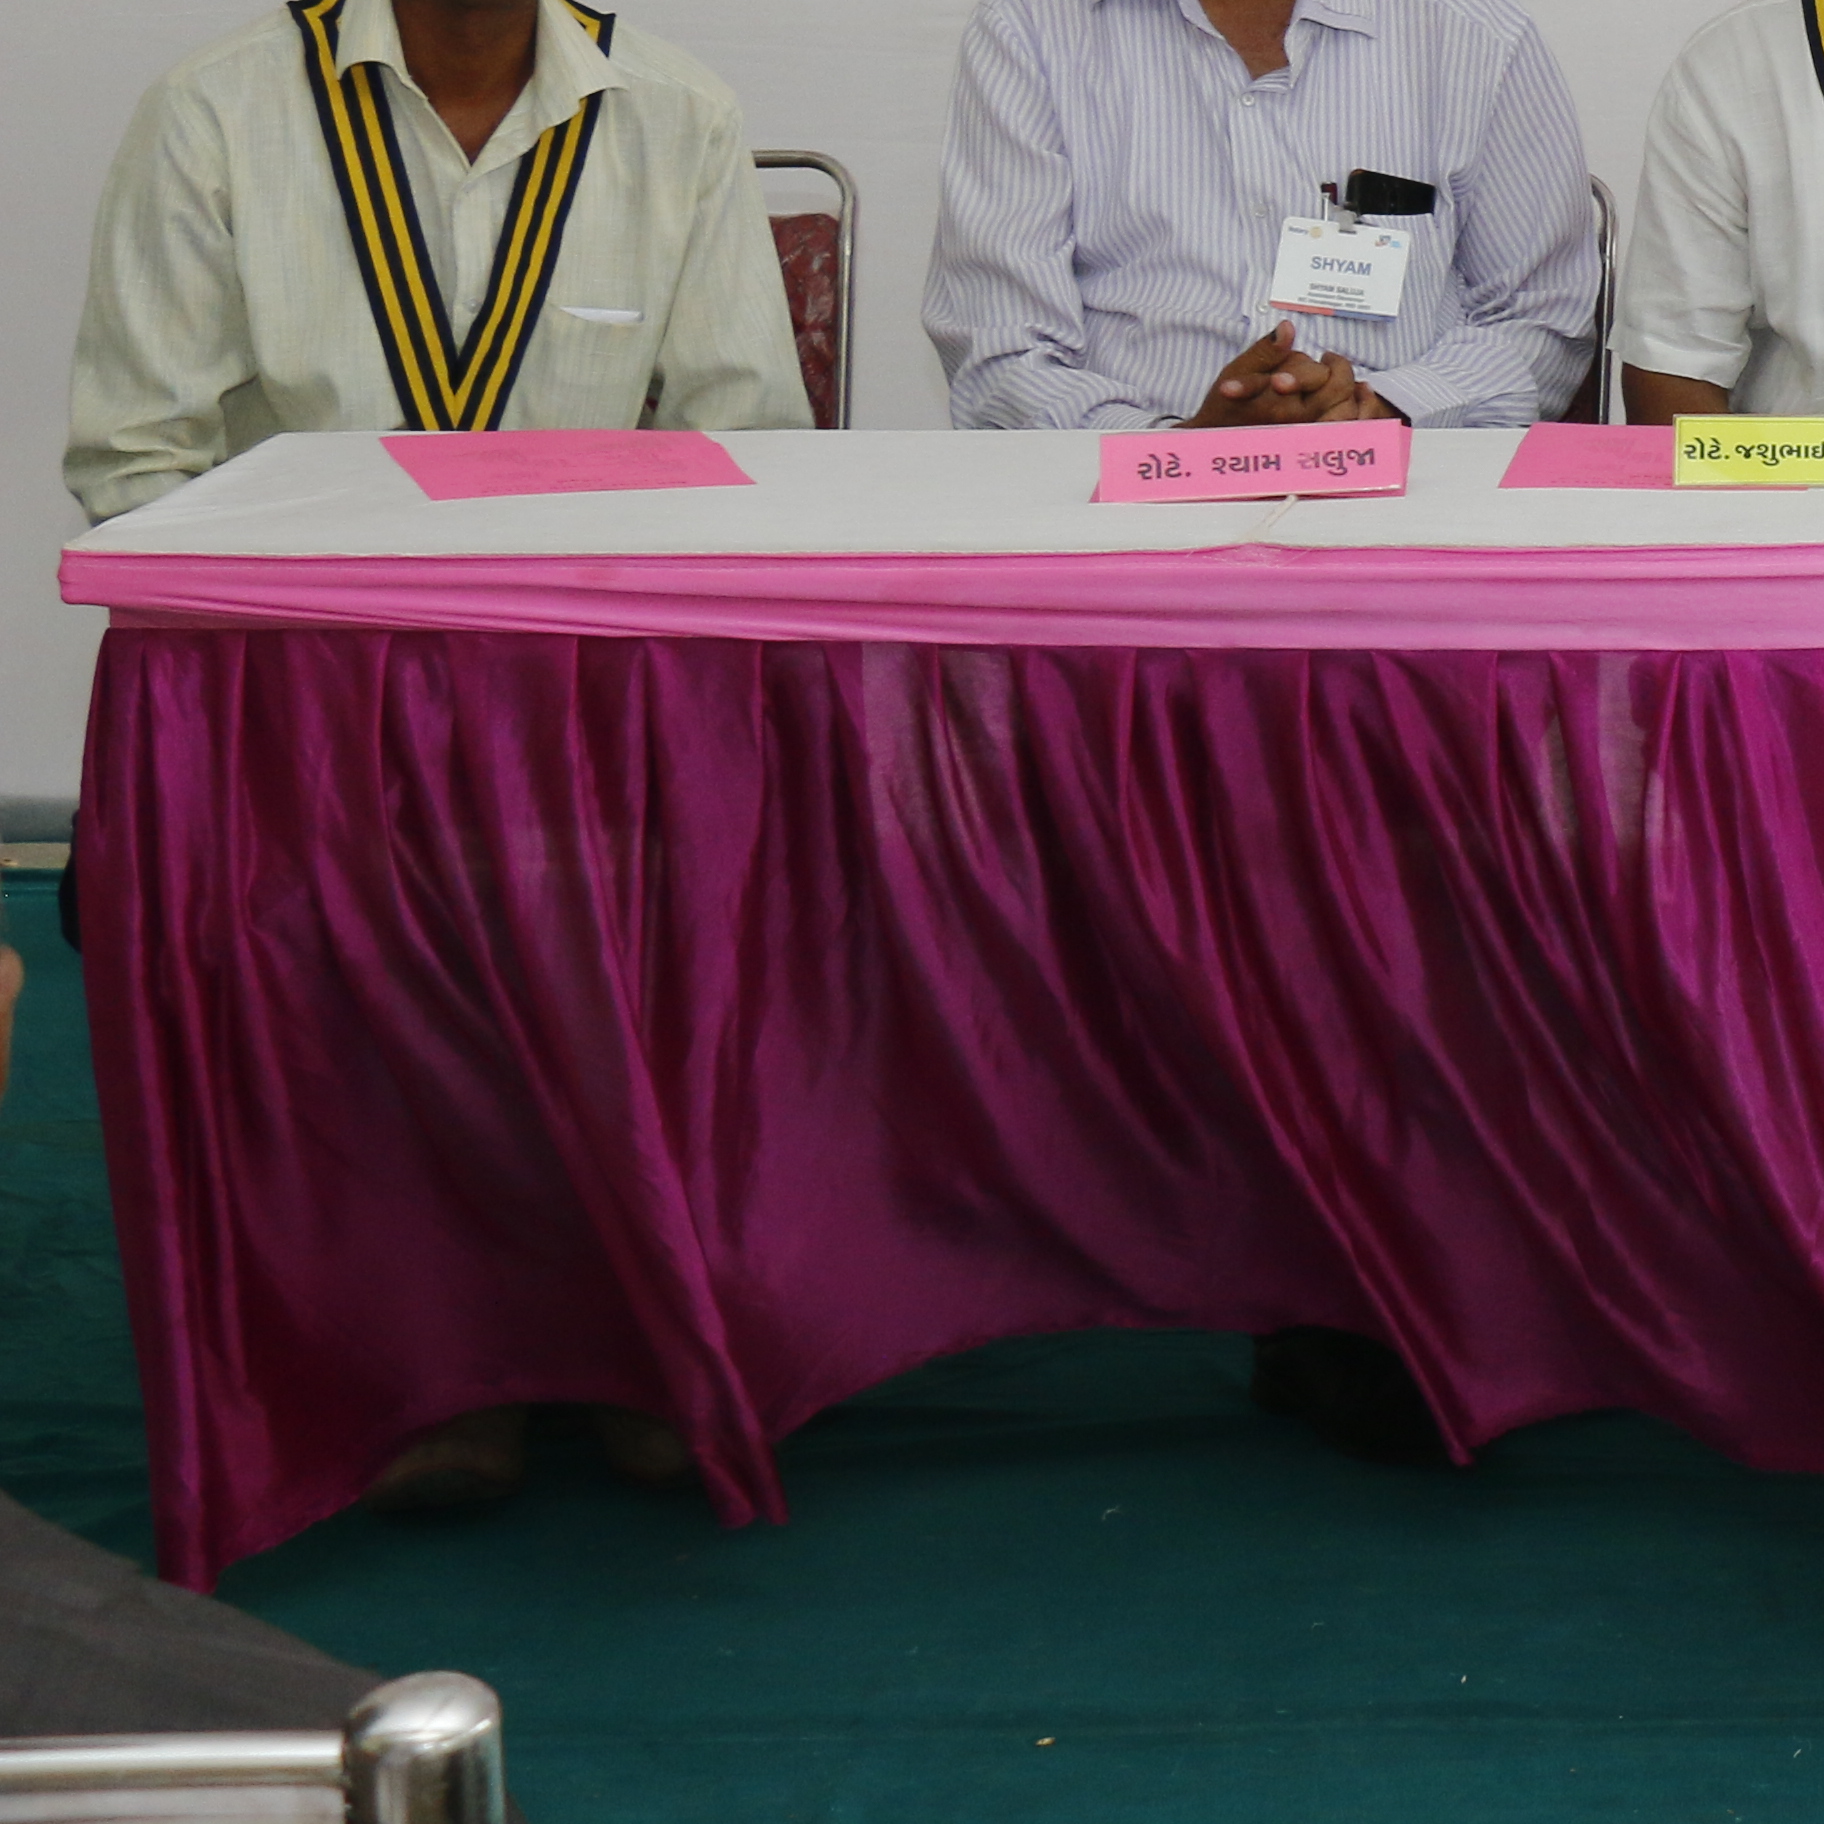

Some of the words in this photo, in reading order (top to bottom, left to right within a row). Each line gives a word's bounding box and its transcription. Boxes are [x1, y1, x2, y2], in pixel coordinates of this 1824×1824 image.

[1310, 255, 1372, 276] SHYAM
[1683, 437, 1730, 460] રોટે.
[1137, 452, 1191, 481] રોટે.
[1211, 453, 1281, 475] શ્યામ
[1298, 447, 1376, 477] સલુજા
